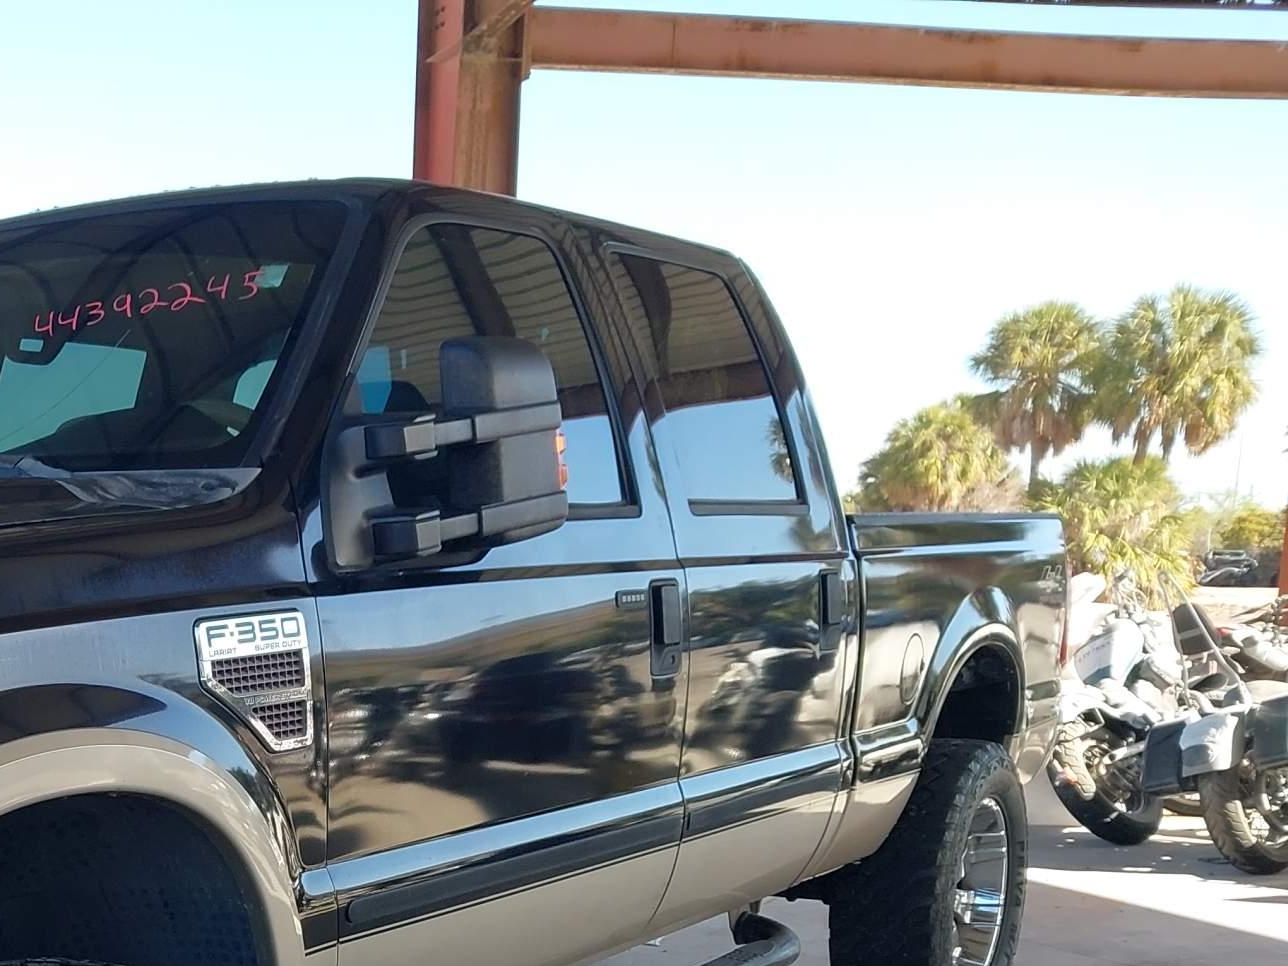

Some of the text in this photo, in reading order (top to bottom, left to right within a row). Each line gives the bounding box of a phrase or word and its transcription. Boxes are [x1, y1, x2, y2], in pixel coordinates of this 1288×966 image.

[34, 268, 264, 337] 44392245
[206, 616, 300, 648] F-350
[208, 639, 302, 658] LARIAT SUPER DUTY
